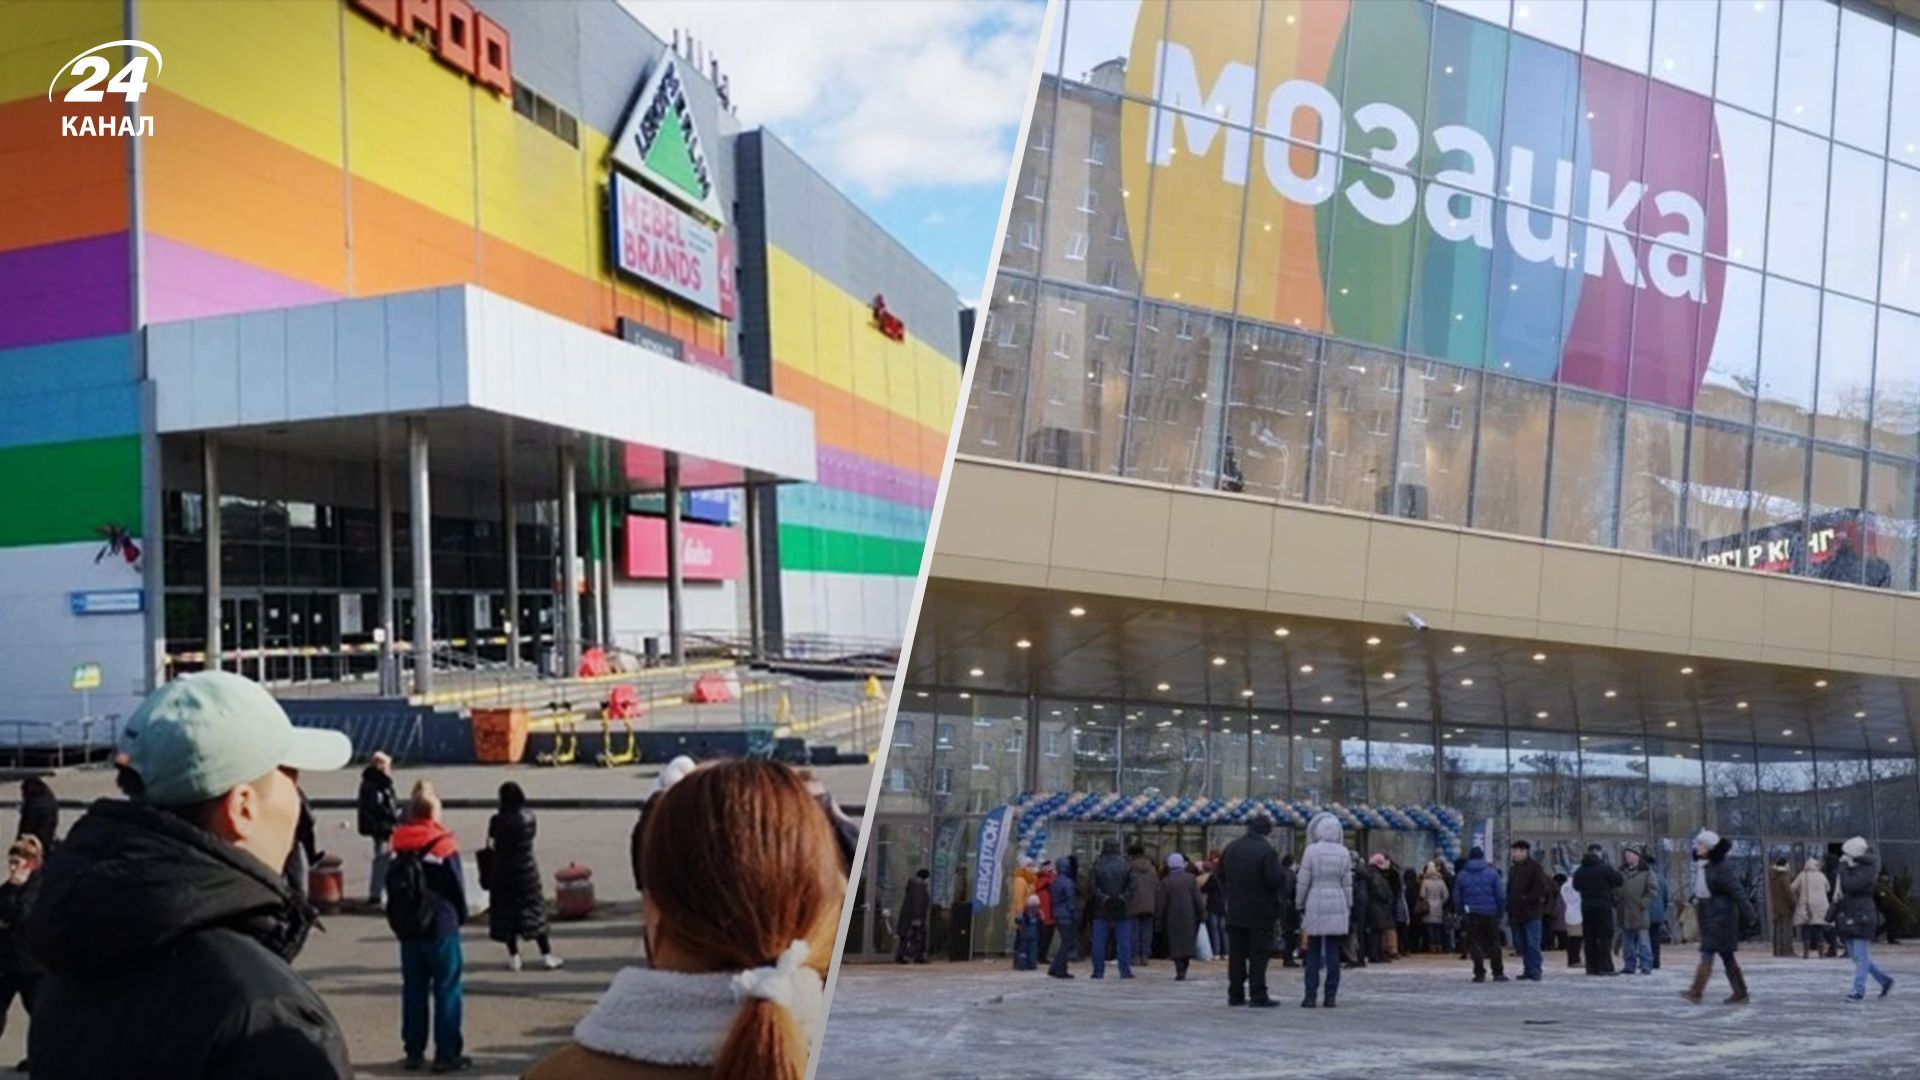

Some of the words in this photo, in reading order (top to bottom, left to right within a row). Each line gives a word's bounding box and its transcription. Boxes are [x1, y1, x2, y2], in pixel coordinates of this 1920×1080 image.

[622, 190, 686, 249] MEBEL
[623, 228, 703, 292] BRANDS
[976, 818, 1001, 905] ДЕКАТЛОН
